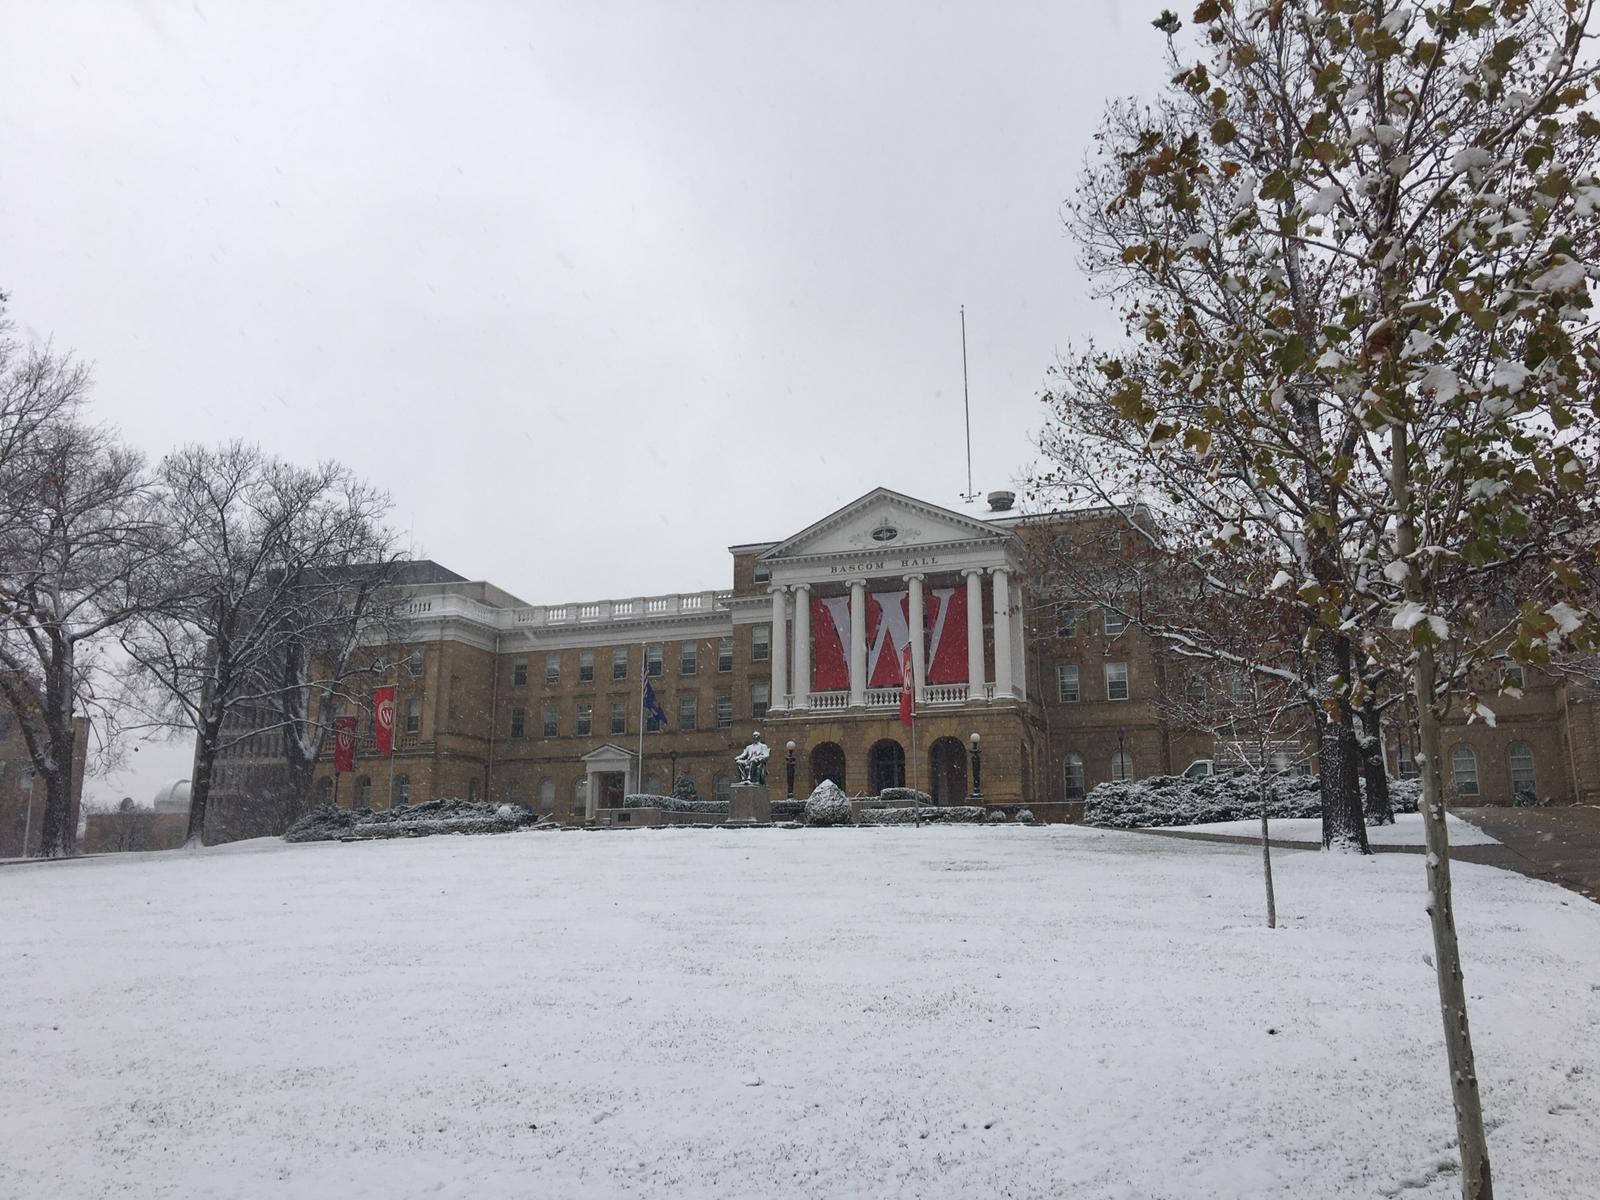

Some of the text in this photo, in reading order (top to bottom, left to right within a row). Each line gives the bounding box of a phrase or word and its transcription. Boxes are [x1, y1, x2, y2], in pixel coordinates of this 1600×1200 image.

[830, 558, 938, 573] BASCOM HALL
[821, 588, 954, 688] W
[382, 708, 393, 723] W
